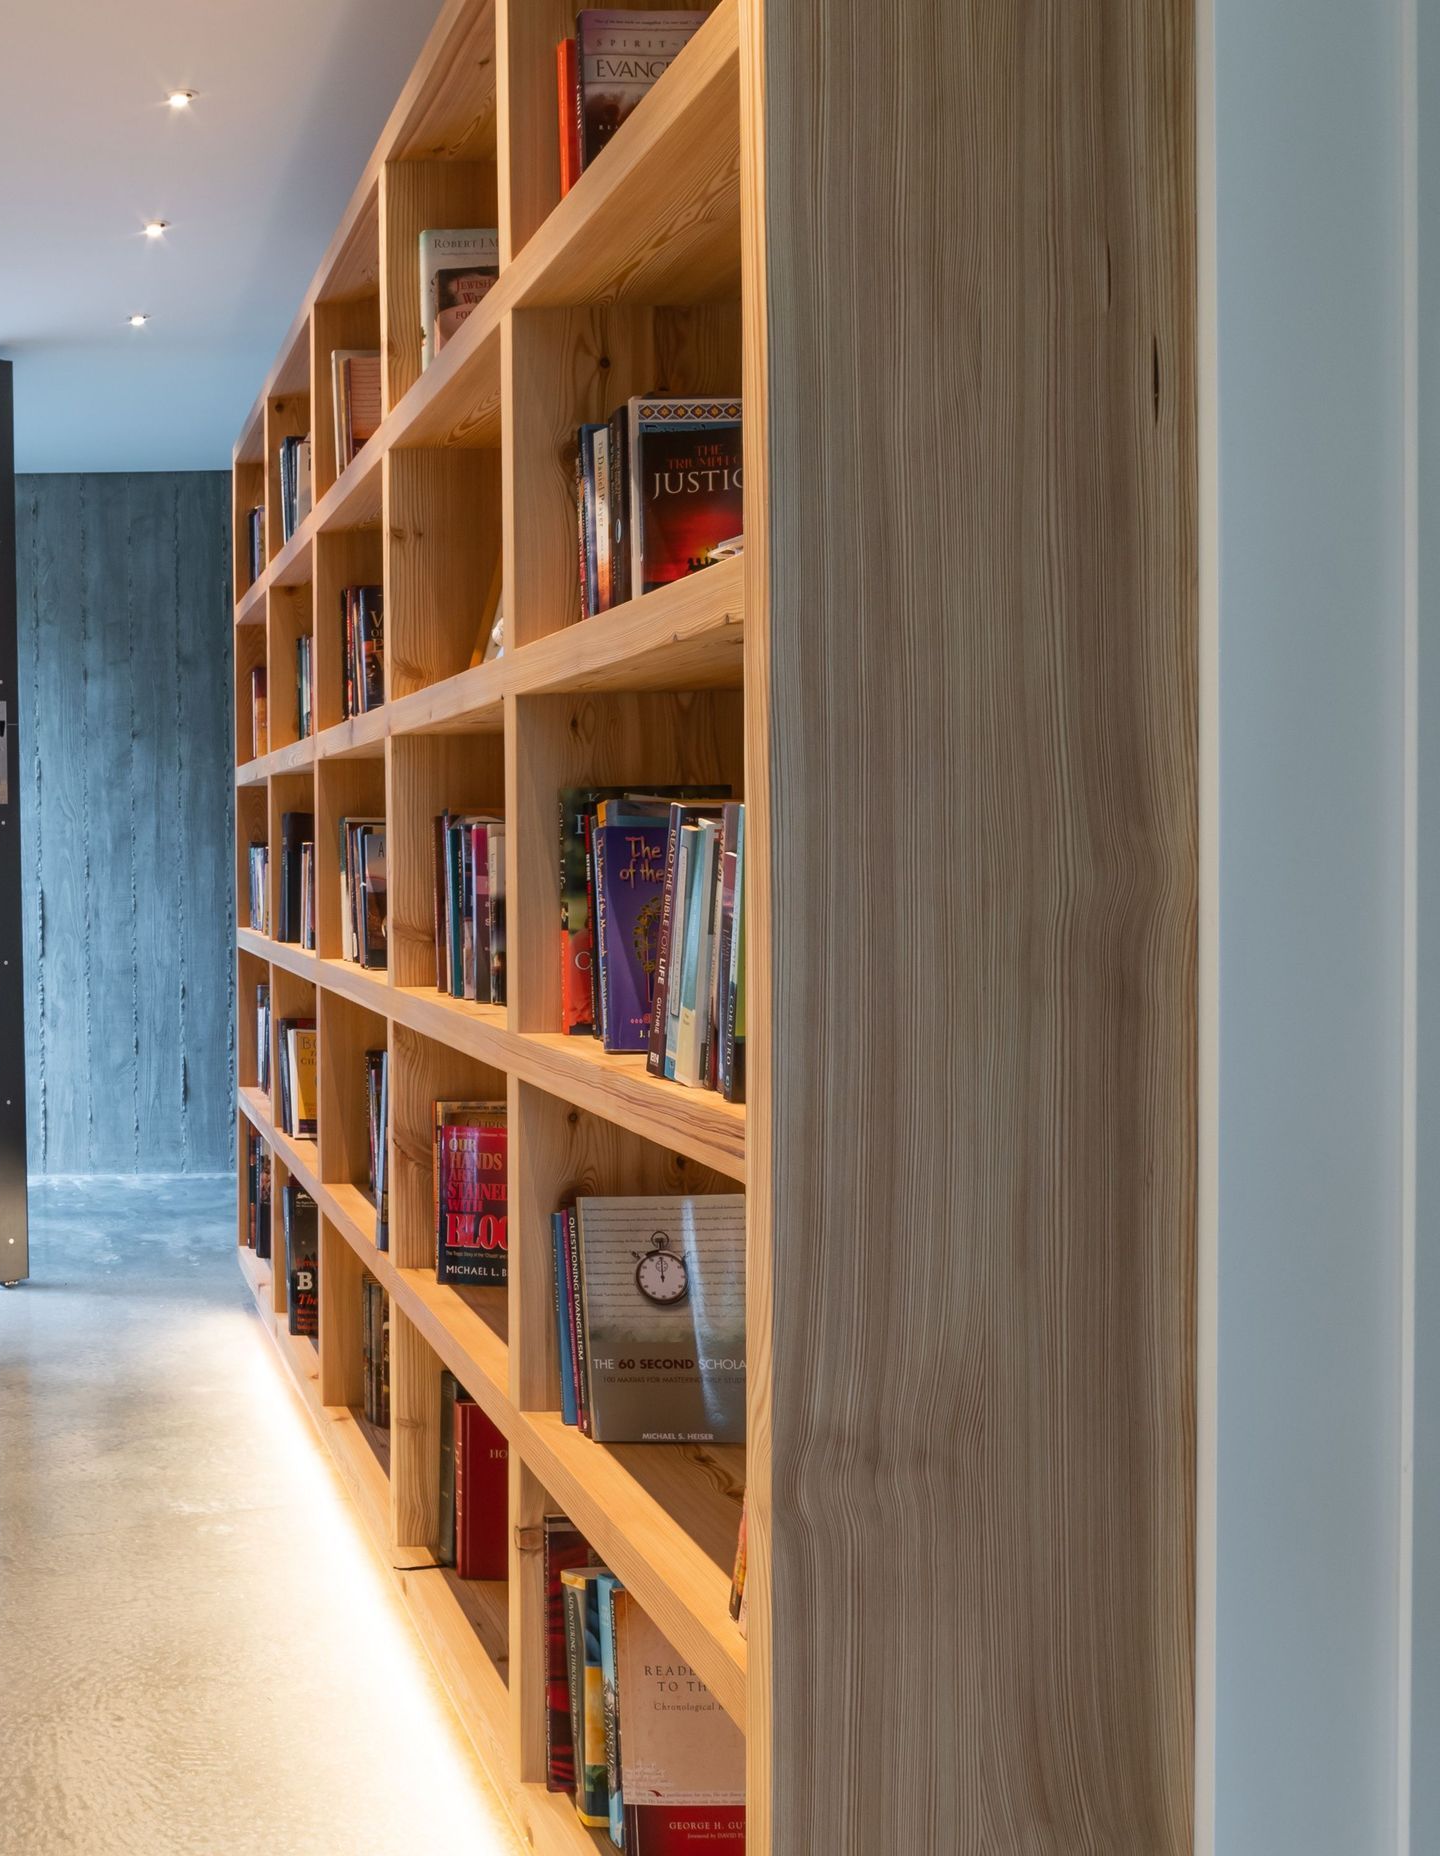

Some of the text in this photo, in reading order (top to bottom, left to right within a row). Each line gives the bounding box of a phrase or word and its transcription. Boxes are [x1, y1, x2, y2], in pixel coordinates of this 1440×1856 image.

[434, 239, 476, 249] ROBERT
[456, 279, 491, 295] JEWISH
[597, 456, 605, 491] Daniel
[598, 493, 606, 528] Prayer
[625, 836, 662, 860] The
[668, 829, 677, 864] READ
[619, 858, 665, 889] of the
[665, 867, 673, 892] THE
[662, 893, 671, 925] BIBLE
[657, 958, 666, 985] LIFE
[654, 997, 663, 1035] GUTHRIE
[726, 994, 734, 1066] CORDEIRO
[449, 1138, 477, 1152] OUR
[449, 1152, 503, 1171] HANDS
[448, 1199, 484, 1213] WITH
[569, 1216, 580, 1291] QUESTIONING
[446, 1265, 488, 1276] MICHAEL
[491, 1268, 499, 1277] L.
[574, 1293, 584, 1361] EVANGELISM
[593, 1359, 615, 1369] THE
[618, 1359, 636, 1370] 60
[640, 1359, 695, 1370] SECOND
[603, 1376, 616, 1384] 100
[647, 1376, 660, 1384] FOR
[568, 1595, 576, 1652] ADVENTURING
[657, 1681, 679, 1692] TO
[654, 1702, 715, 1712] Chronological
[669, 1822, 711, 1830] GEORGE
[714, 1822, 725, 1830] H.
